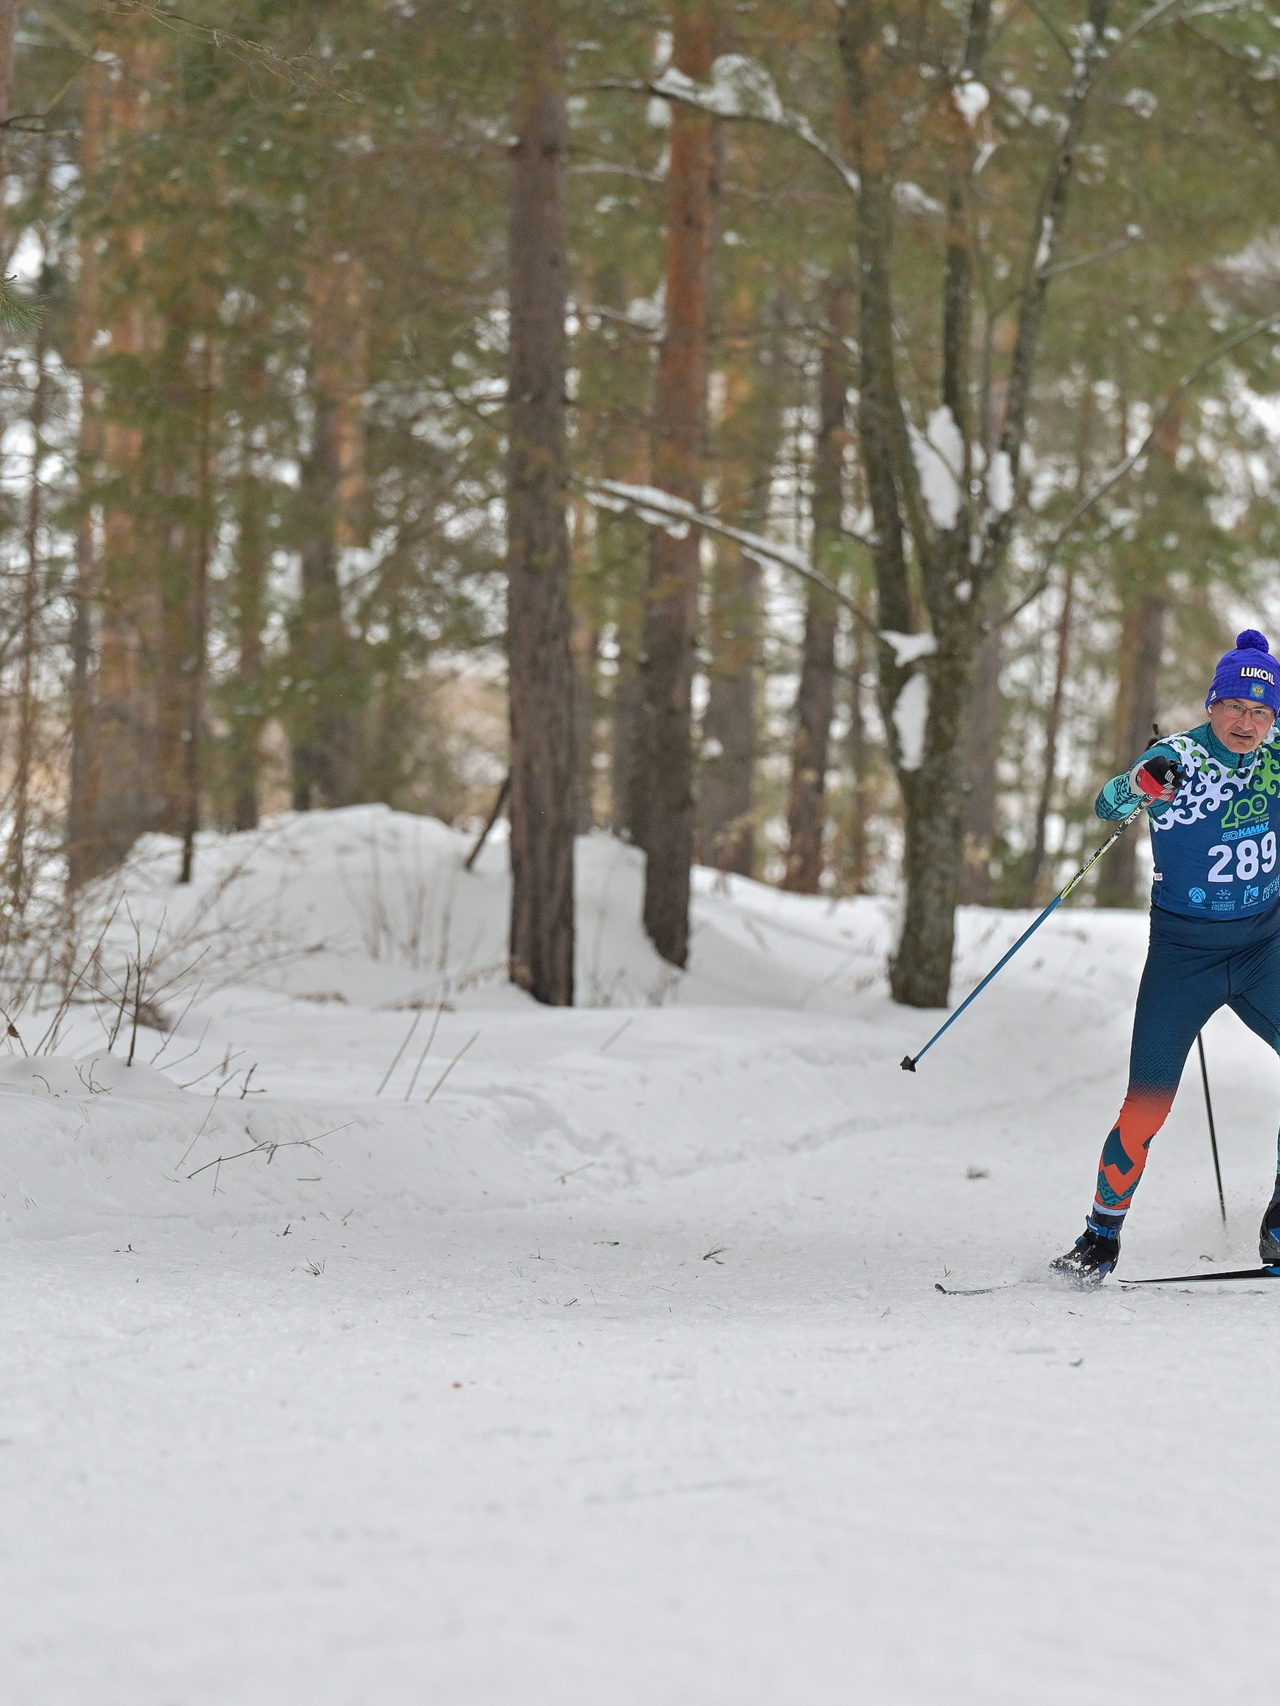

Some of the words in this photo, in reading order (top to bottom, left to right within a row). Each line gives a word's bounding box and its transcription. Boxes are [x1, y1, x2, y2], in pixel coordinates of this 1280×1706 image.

[1241, 667, 1276, 686] LUKOIL
[1238, 821, 1270, 837] KAMAZ
[1207, 831, 1277, 883] 289
